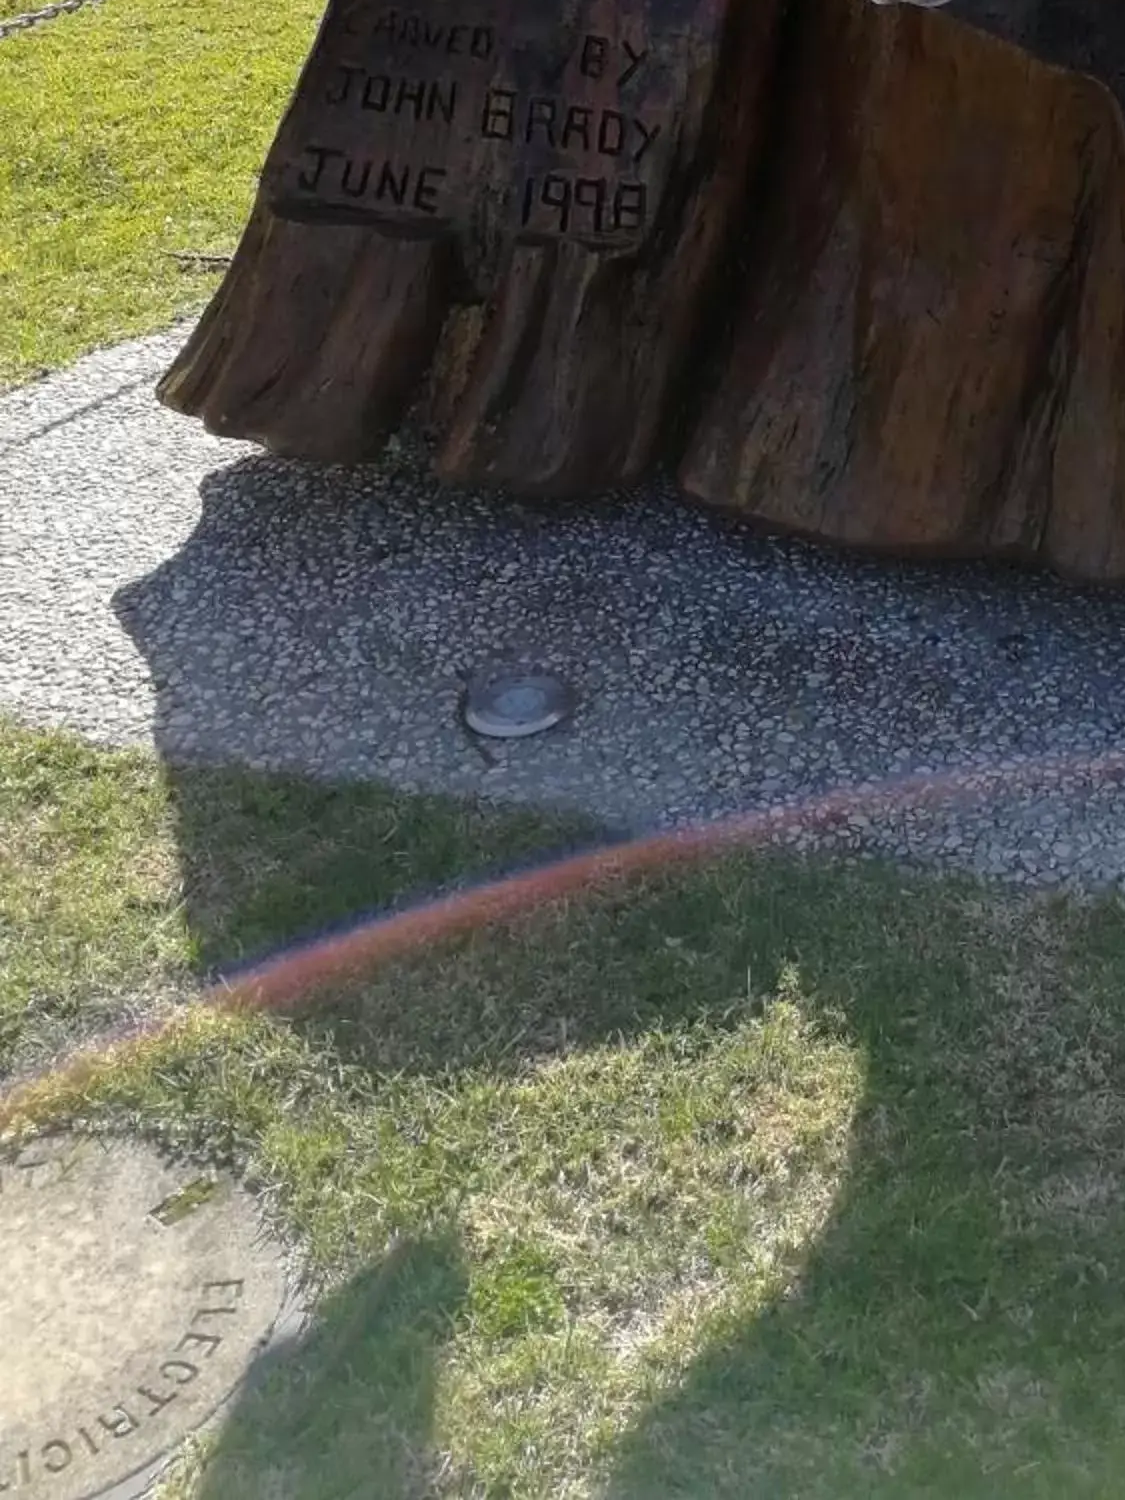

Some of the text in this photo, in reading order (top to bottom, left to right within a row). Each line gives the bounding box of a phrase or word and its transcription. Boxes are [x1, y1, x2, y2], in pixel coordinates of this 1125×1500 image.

[580, 34, 648, 86] BY
[327, 66, 662, 162] JOHN BRADY
[298, 145, 648, 234] JUNE 1998
